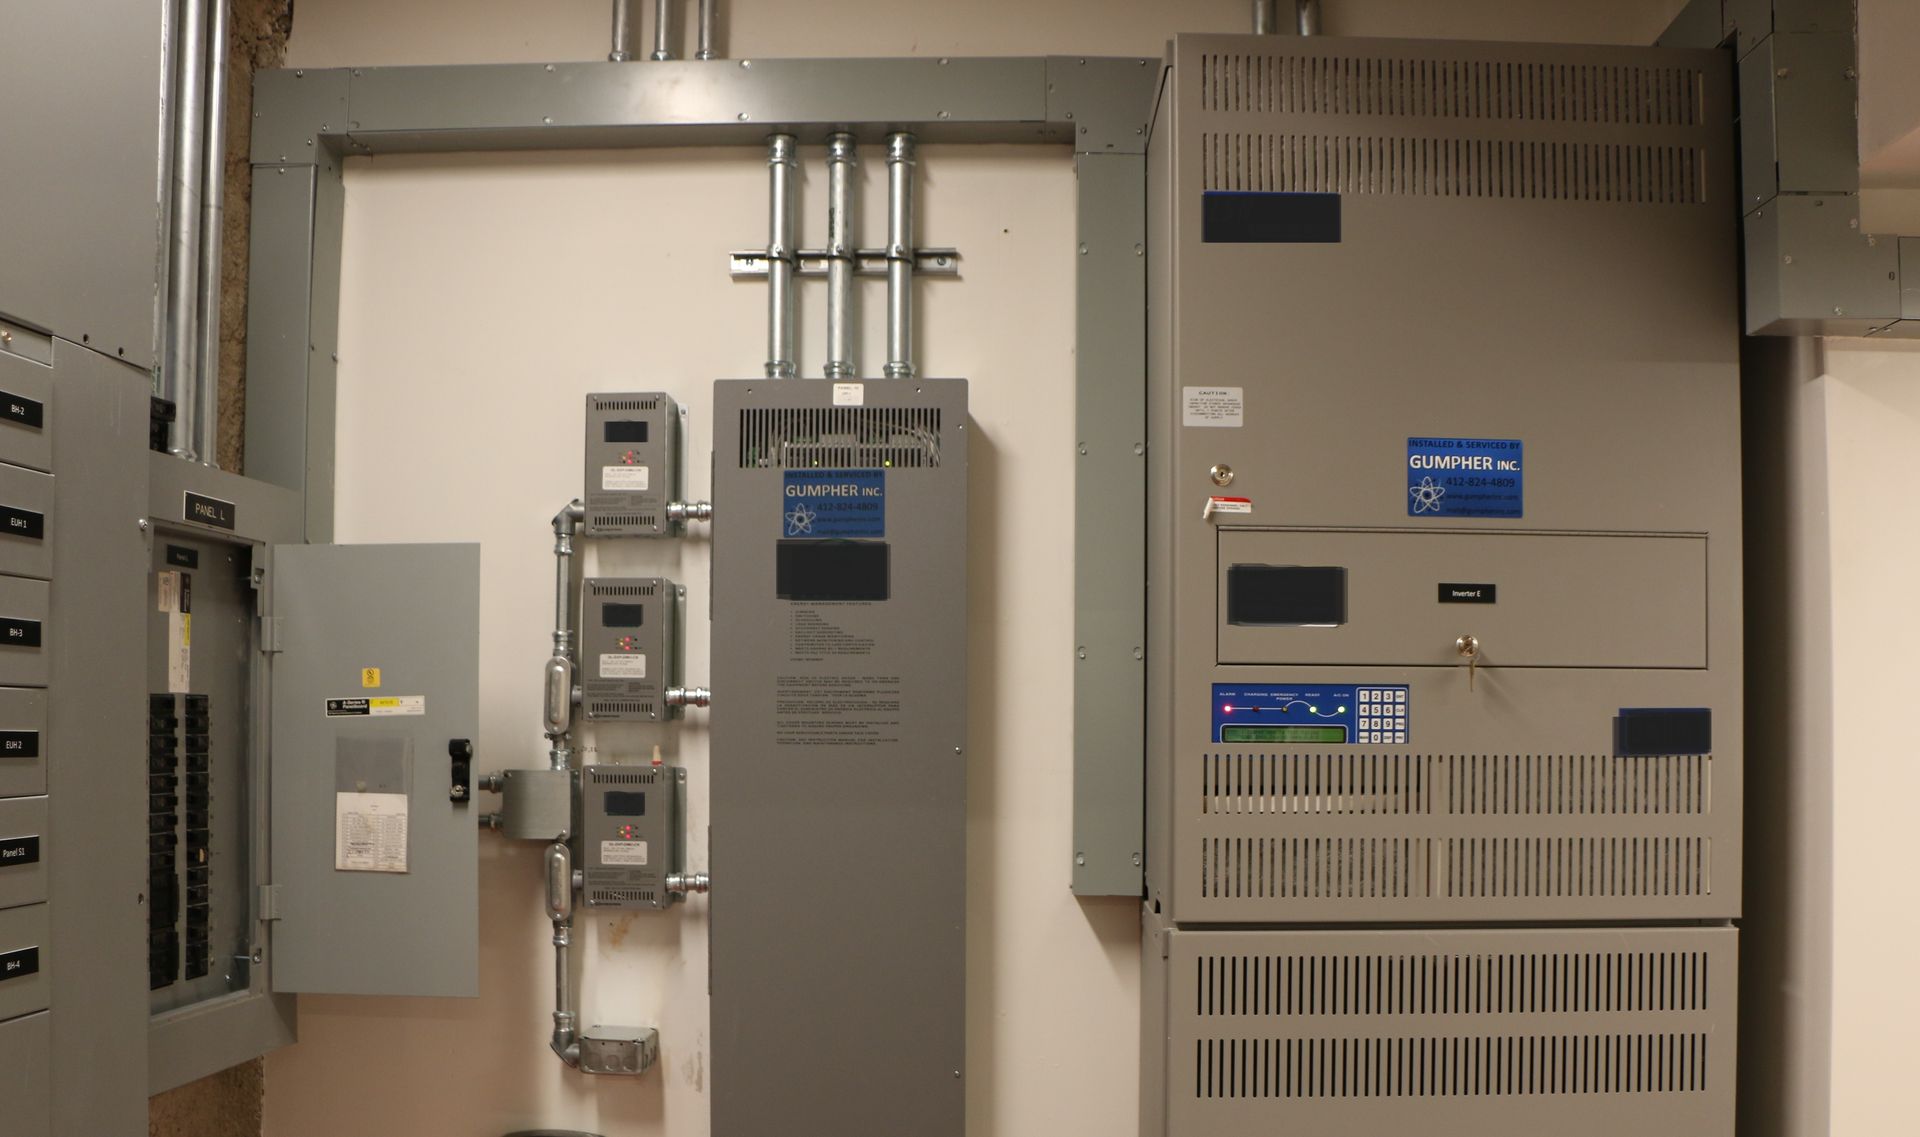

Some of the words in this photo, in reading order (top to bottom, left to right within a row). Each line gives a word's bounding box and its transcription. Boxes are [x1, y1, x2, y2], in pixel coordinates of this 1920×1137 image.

[11, 404, 25, 416] BH-2
[1408, 440, 1454, 448] INSTALLED
[1456, 441, 1463, 449] &
[1465, 441, 1507, 449] SERVICED
[1509, 441, 1520, 450] BY
[1409, 454, 1493, 470] GUMPHER
[1497, 460, 1520, 471] INC.
[1446, 477, 1515, 488] 412-824-4809
[785, 484, 858, 497] GUMPHER
[862, 487, 883, 497] INC.
[195, 503, 217, 519] PANEL
[220, 509, 225, 520] L
[817, 502, 879, 511] 412-824-4809
[10, 517, 22, 528] EUH
[23, 520, 27, 529] 1
[9, 628, 23, 637] BH-3
[1374, 706, 1379, 714] 5
[1385, 706, 1391, 714] 6
[1373, 720, 1379, 728] 8
[1385, 720, 1391, 728] 9
[6, 740, 17, 749] EUH
[18, 740, 22, 749] 2
[2, 847, 17, 858] Panel
[7, 960, 20, 970] BH-4
